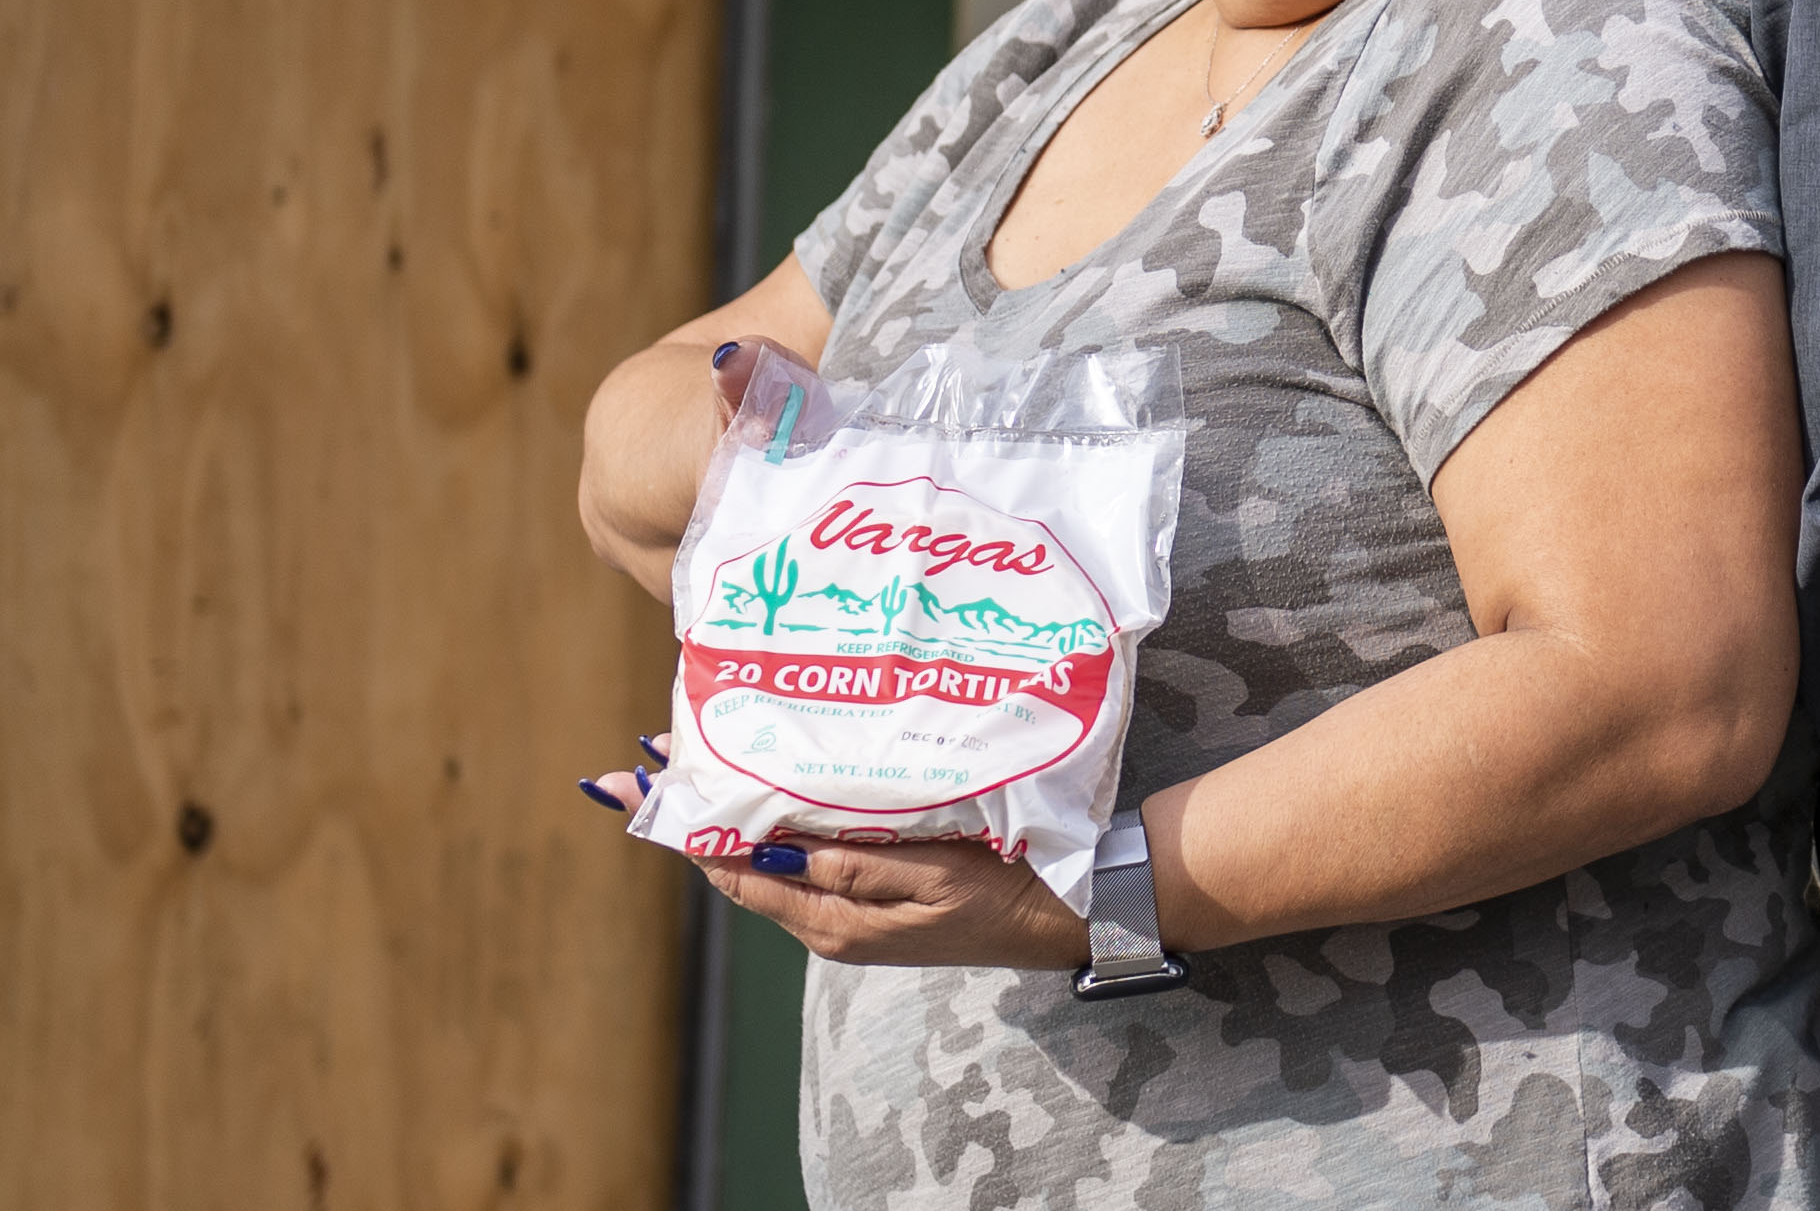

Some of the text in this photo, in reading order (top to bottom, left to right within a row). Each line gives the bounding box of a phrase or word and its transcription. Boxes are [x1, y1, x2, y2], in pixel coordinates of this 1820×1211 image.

[810, 499, 1054, 577] Vargas
[836, 641, 975, 663] KEEP REFRIGERATED
[714, 660, 1074, 701] 20 CORN TORTILAS
[713, 693, 895, 719] KEEP REFRIGERATED
[901, 731, 932, 742] DEC
[793, 763, 826, 775] NET
[832, 764, 862, 777] WT.
[923, 767, 969, 785] (397g)
